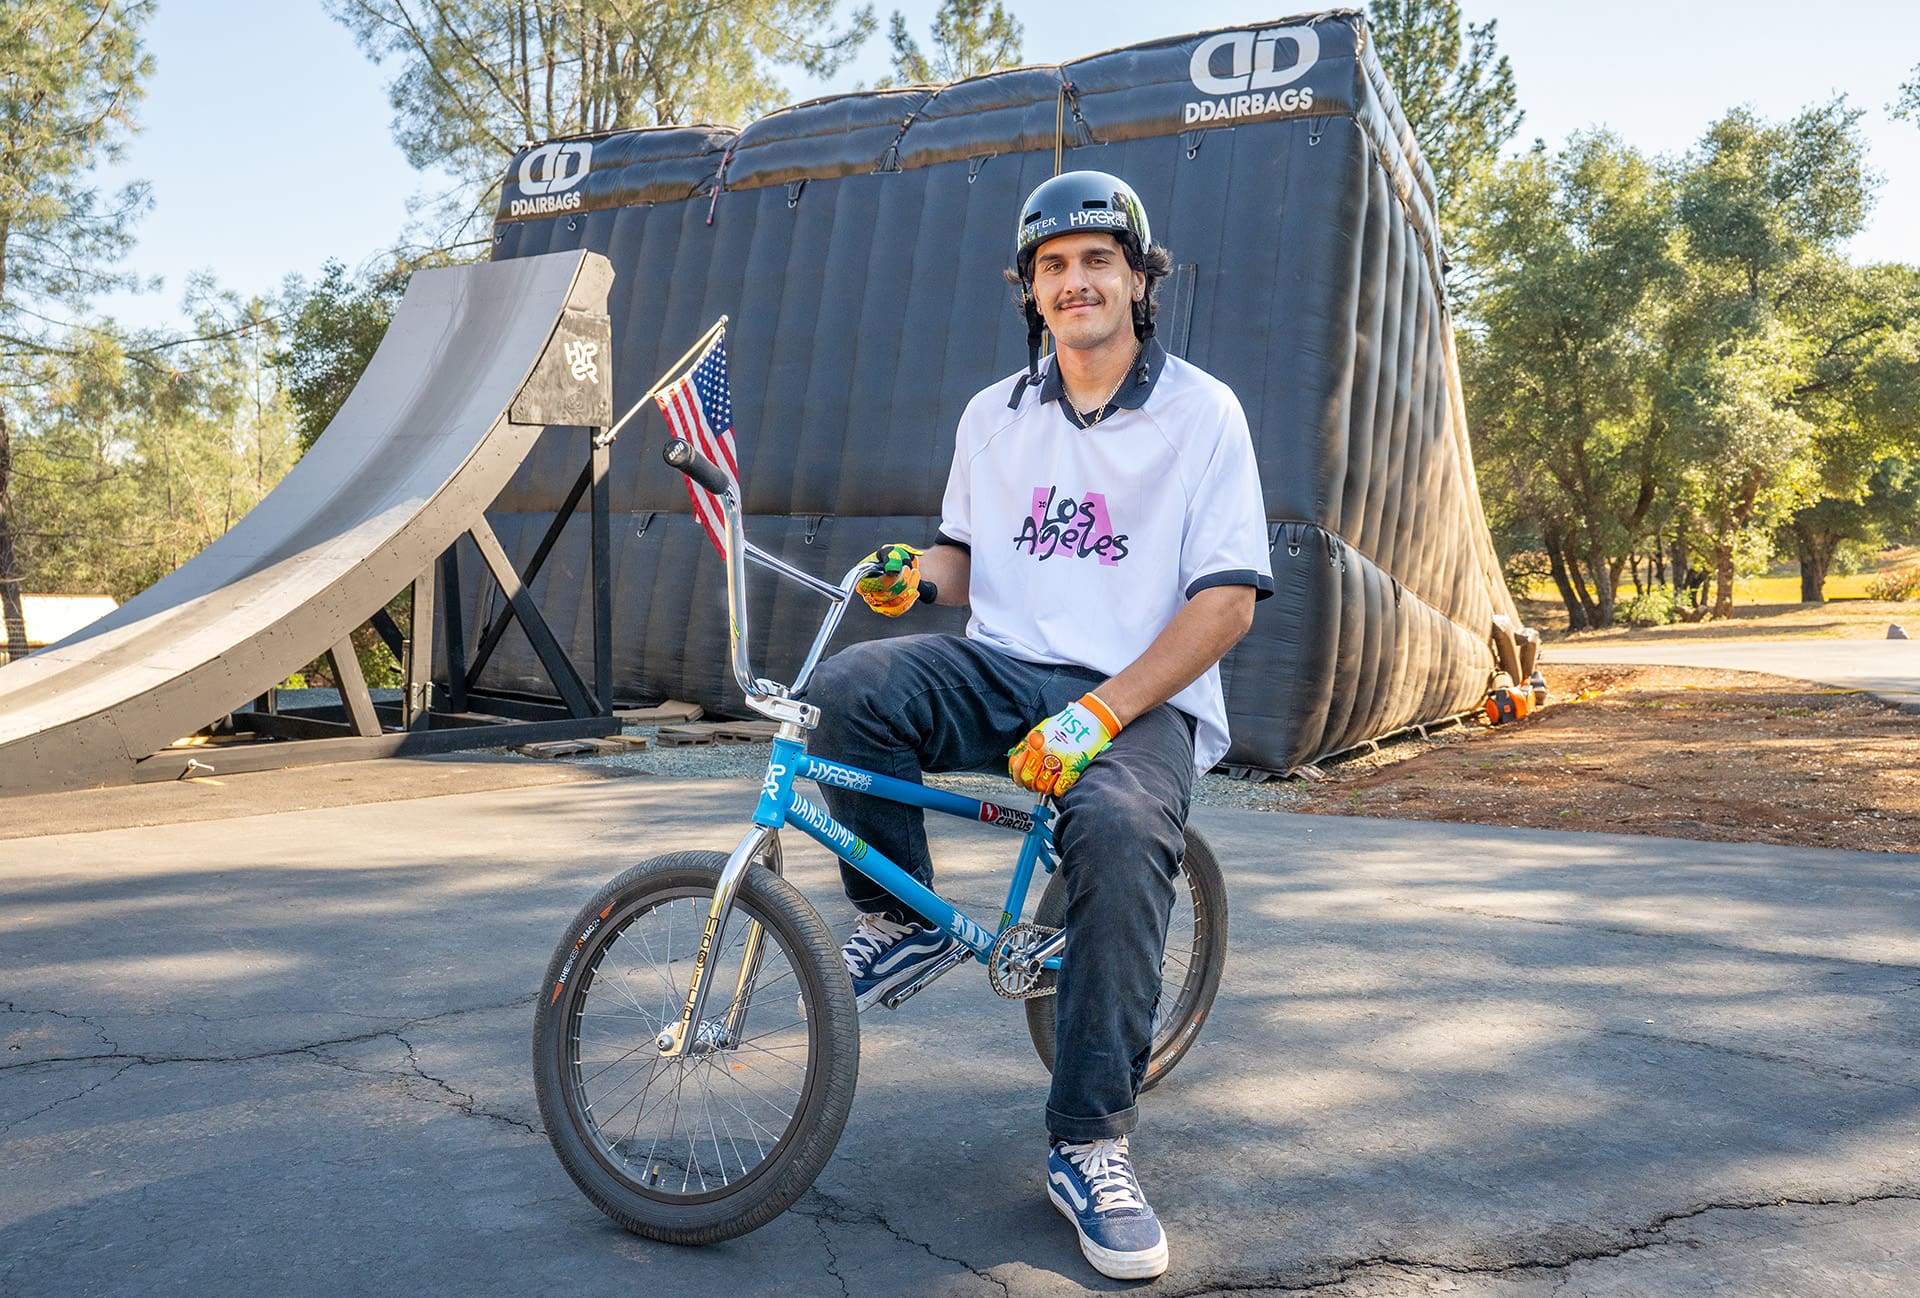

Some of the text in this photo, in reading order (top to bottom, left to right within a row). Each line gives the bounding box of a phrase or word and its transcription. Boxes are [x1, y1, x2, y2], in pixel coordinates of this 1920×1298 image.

[1185, 87, 1313, 124] DDAIRBAGS
[510, 191, 581, 216] DDAIRBAGS
[1040, 485, 1095, 530] Los
[790, 792, 854, 848] DANSCOMP
[996, 817, 1033, 832] CIRCUS
[997, 804, 1030, 821] NITRO
